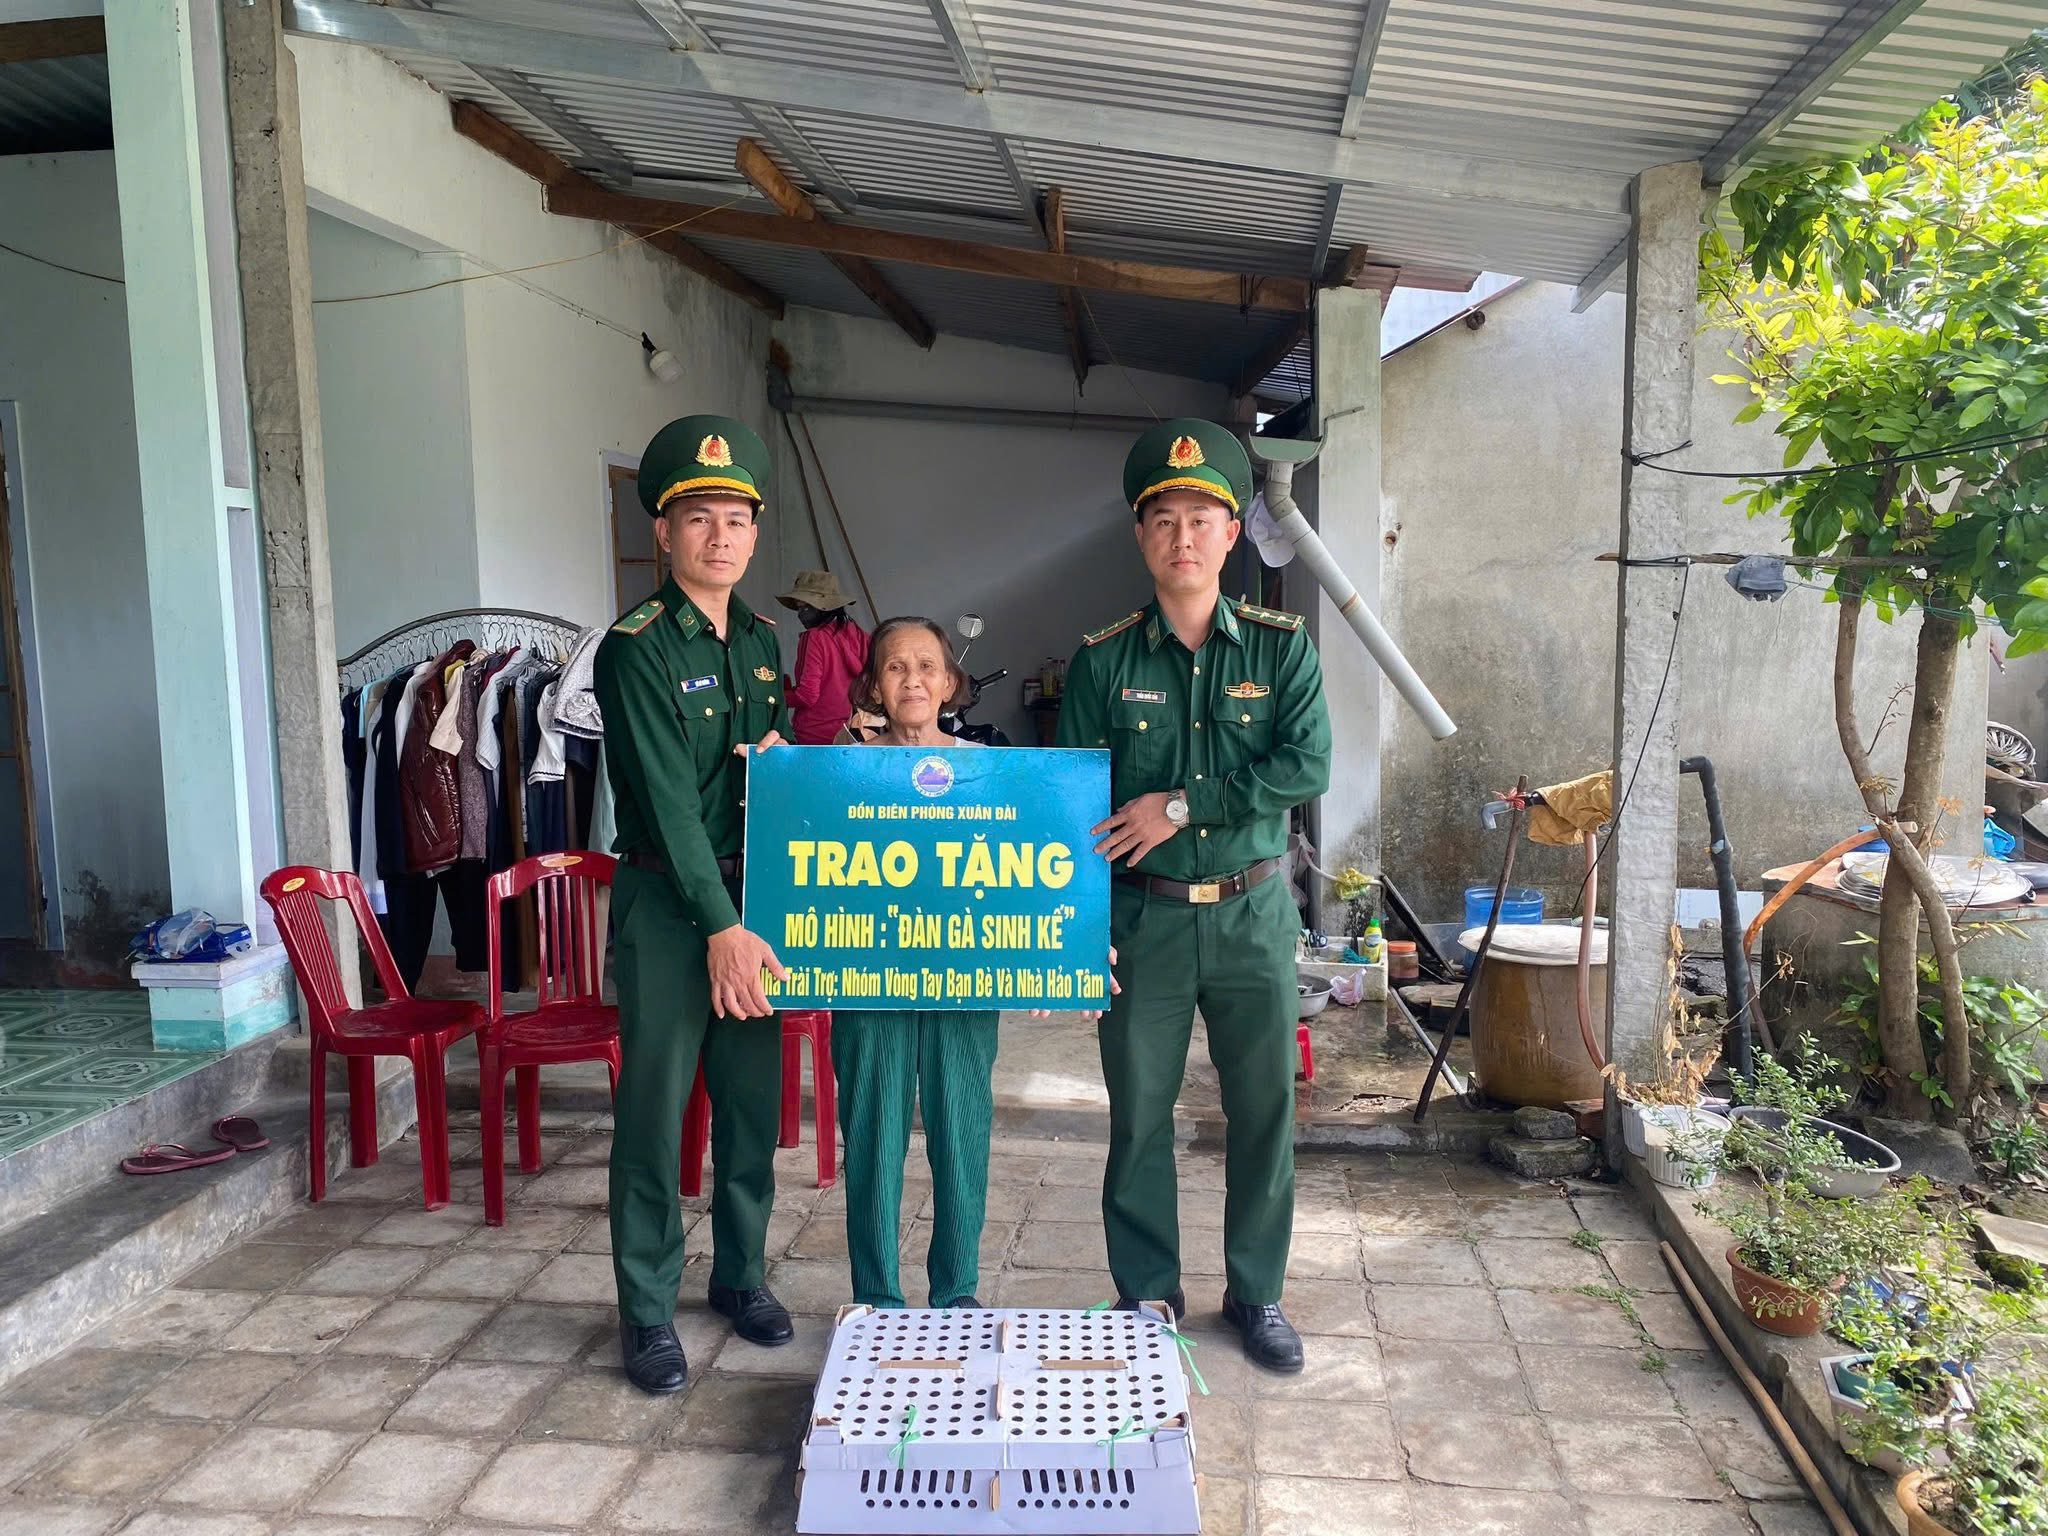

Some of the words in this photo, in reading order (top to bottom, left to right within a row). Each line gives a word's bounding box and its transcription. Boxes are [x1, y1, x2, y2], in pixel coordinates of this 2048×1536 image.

[878, 803, 907, 819] BIÊN
[911, 803, 954, 819] PHÒNG
[957, 803, 992, 820] XUÂN
[995, 804, 1017, 820] ĐÀI
[788, 840, 919, 888] TRAO
[936, 833, 1074, 900] TẶNG
[785, 906, 818, 949] MÔ
[824, 906, 874, 949] HÌNH
[948, 906, 975, 949] GÀ
[981, 914, 1031, 949] SINH
[813, 967, 838, 1003] Trợ:
[842, 966, 881, 997] Nhóm
[884, 966, 917, 1001] Vòng
[921, 967, 943, 1001] Tay
[946, 967, 972, 1004] Bạn
[975, 966, 993, 998] Bè
[996, 967, 1013, 998] Và
[1016, 967, 1043, 998] Nhà
[1046, 965, 1072, 998] Hảo
[1075, 967, 1104, 998] Tâm
